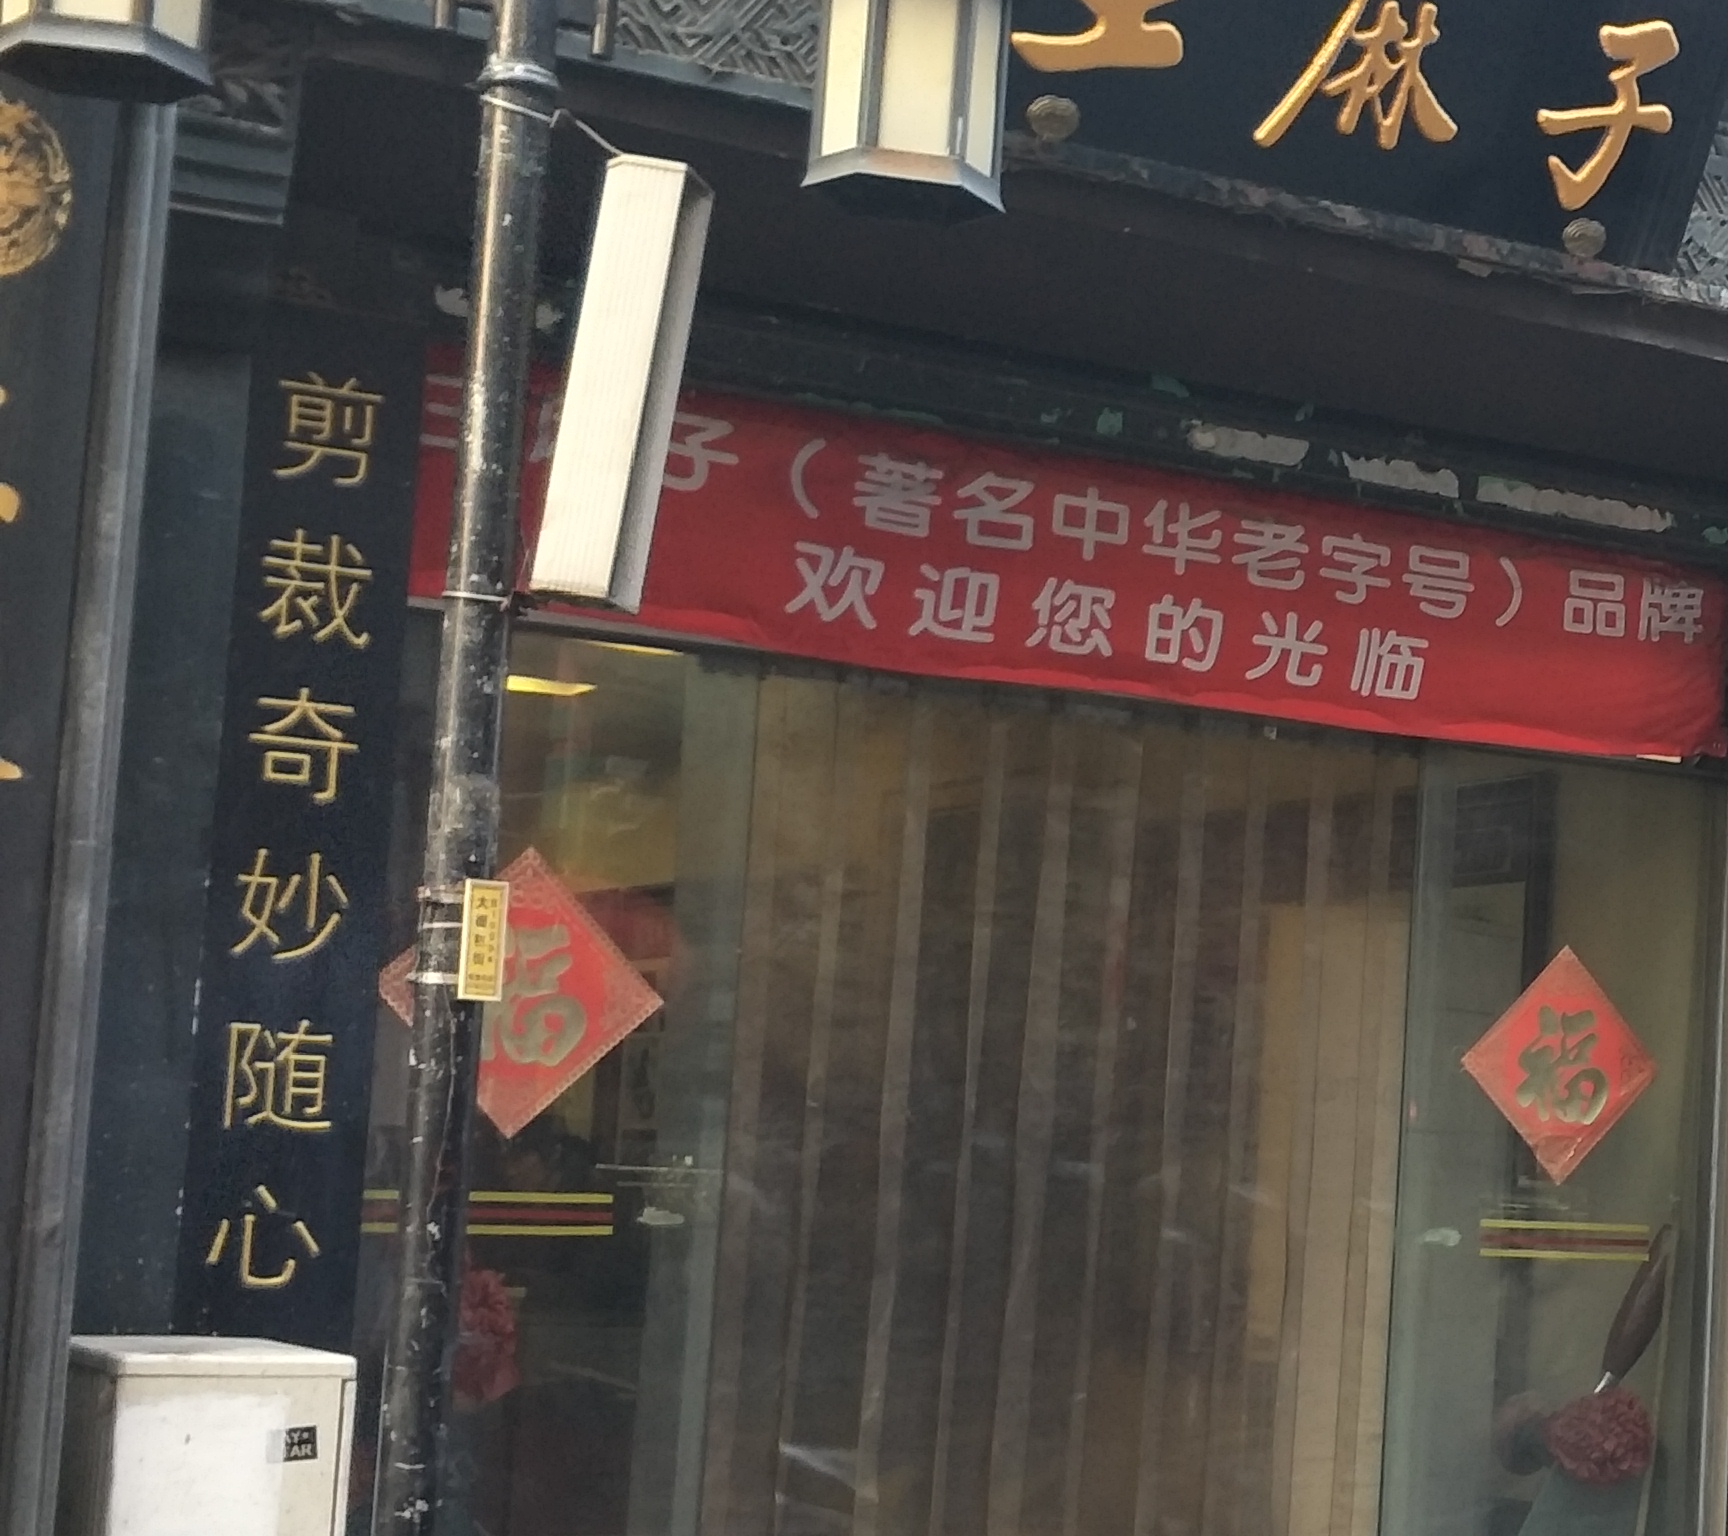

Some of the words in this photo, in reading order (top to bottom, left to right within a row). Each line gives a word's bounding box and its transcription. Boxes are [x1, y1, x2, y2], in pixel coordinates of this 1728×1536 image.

[785, 541, 1429, 701] 欢迎您的光临
[204, 371, 386, 1290] 剪裁奇妙随心
[1515, 1005, 1609, 1126] 福
